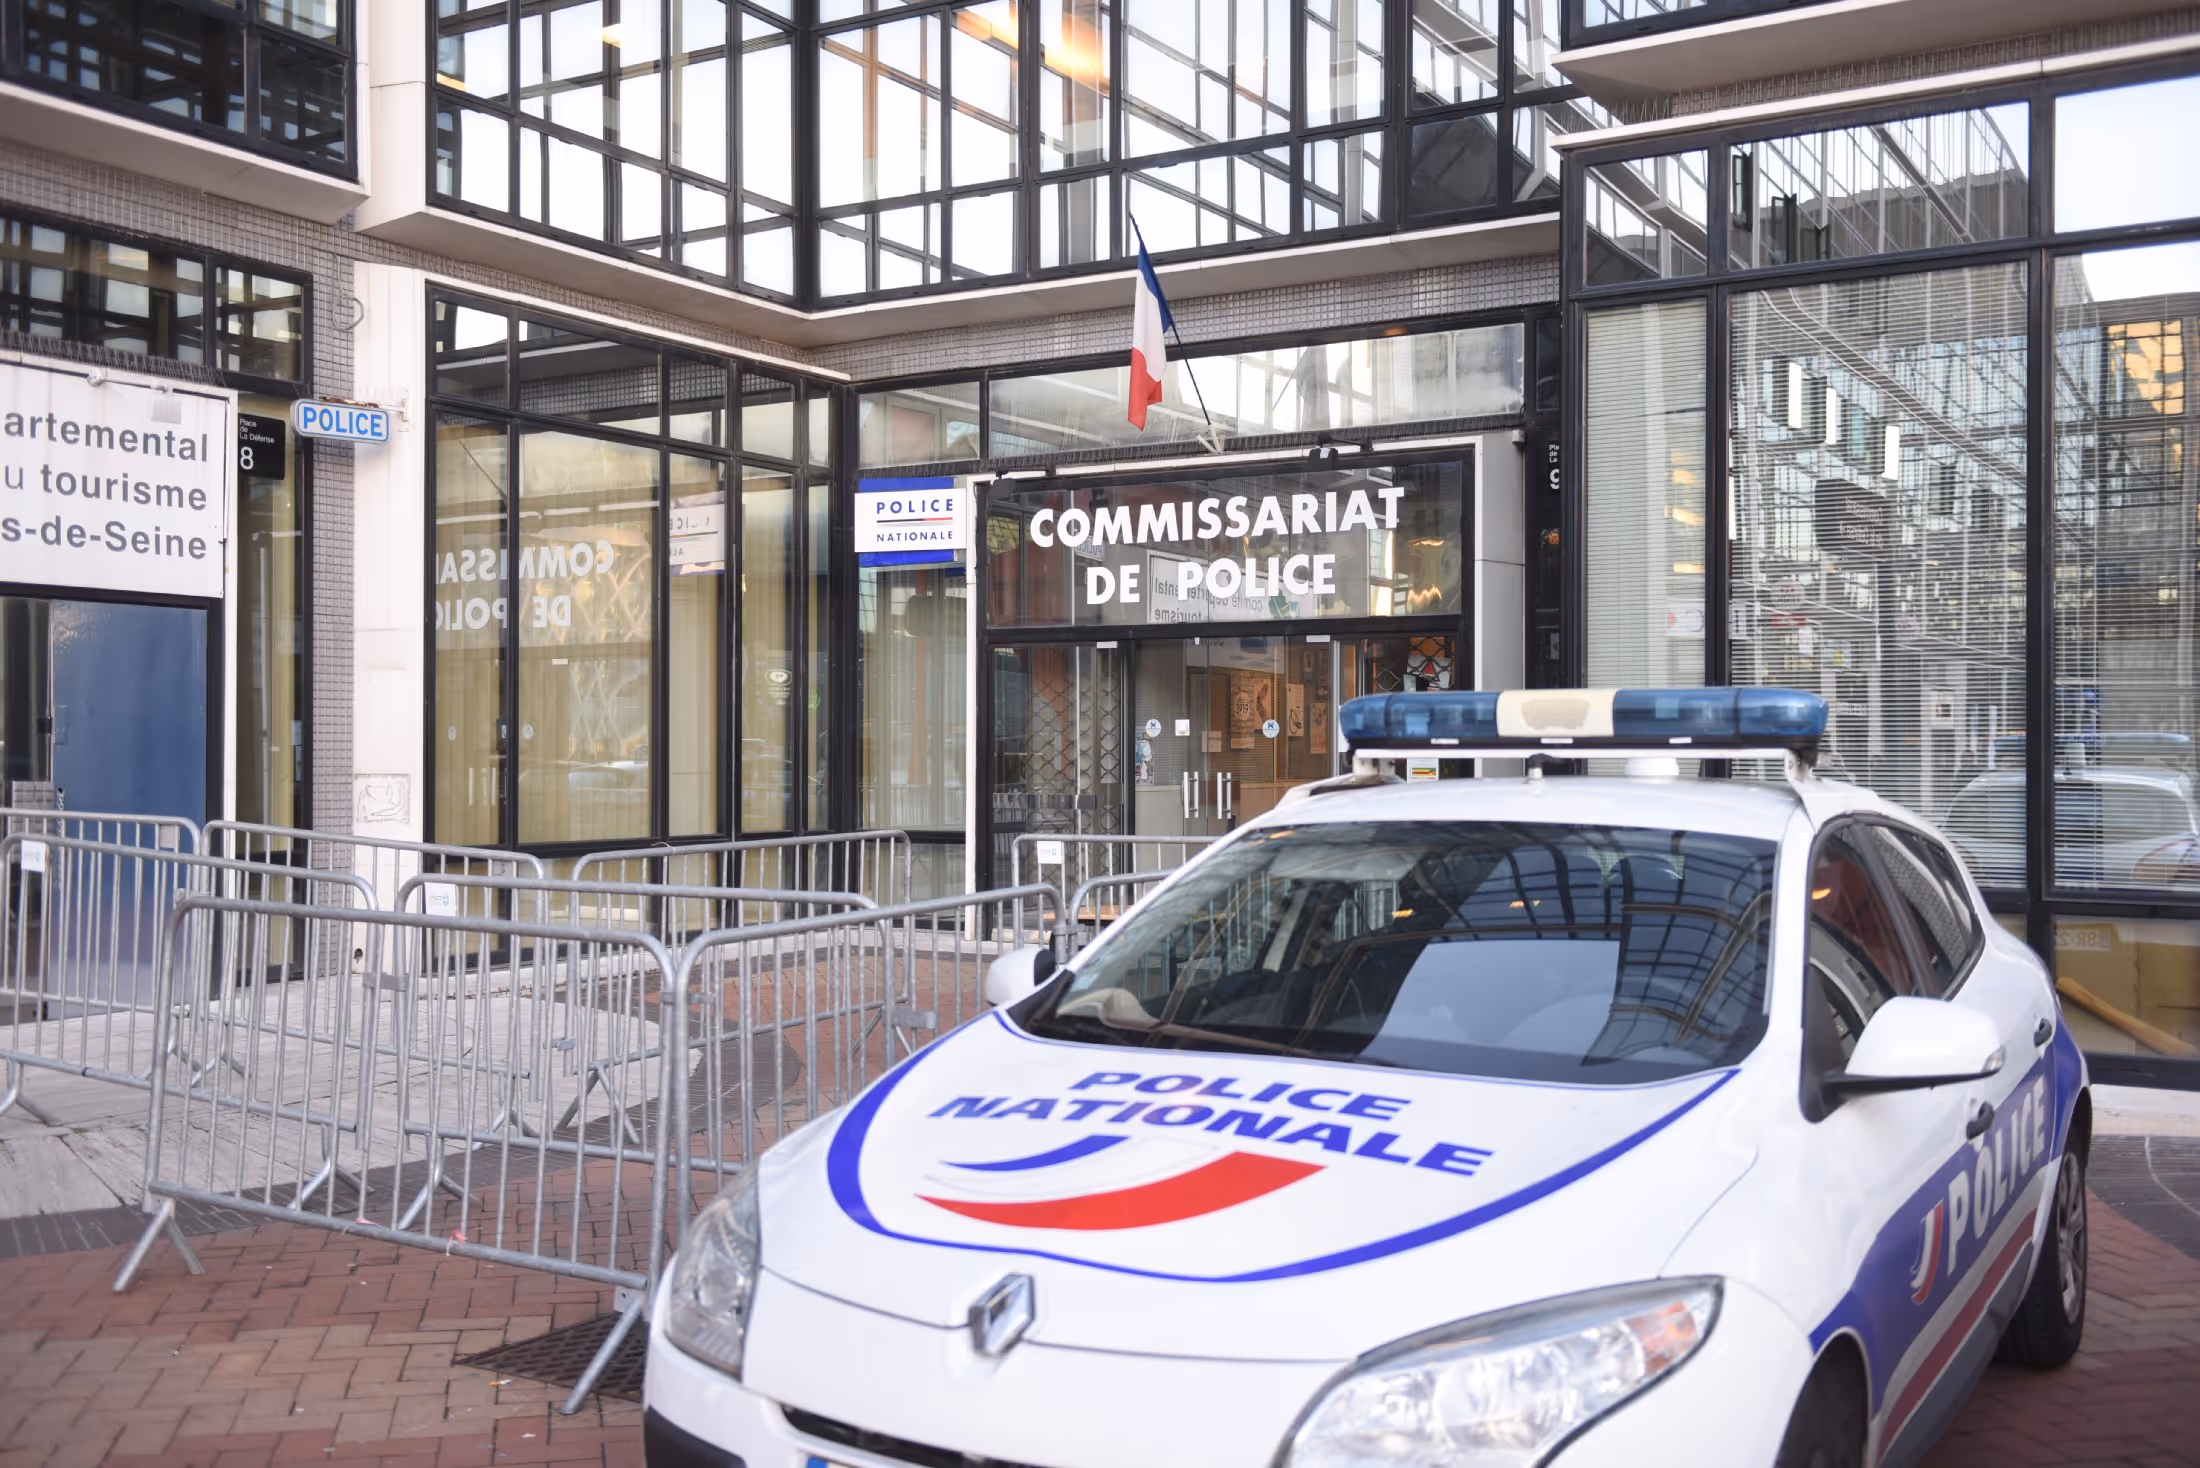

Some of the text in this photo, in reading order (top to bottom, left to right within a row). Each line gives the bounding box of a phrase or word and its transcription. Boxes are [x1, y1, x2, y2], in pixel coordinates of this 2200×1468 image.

[4, 412, 208, 462] artemental
[240, 419, 257, 427] Place
[240, 432, 248, 440] La
[303, 407, 383, 437] POLICE
[240, 446, 254, 470] 8
[5, 464, 207, 511] u tourisme
[876, 499, 953, 514] POLICE
[1, 515, 207, 559] s-de-Seine
[876, 531, 953, 542] NATIONALE
[1030, 487, 1405, 548] COMMISSARIAT
[1086, 554, 1336, 605] DE POLICE
[1066, 1072, 1412, 1120] POLICE
[926, 1096, 1495, 1177] NATIONALE
[1947, 1073, 2045, 1277] POLICE
